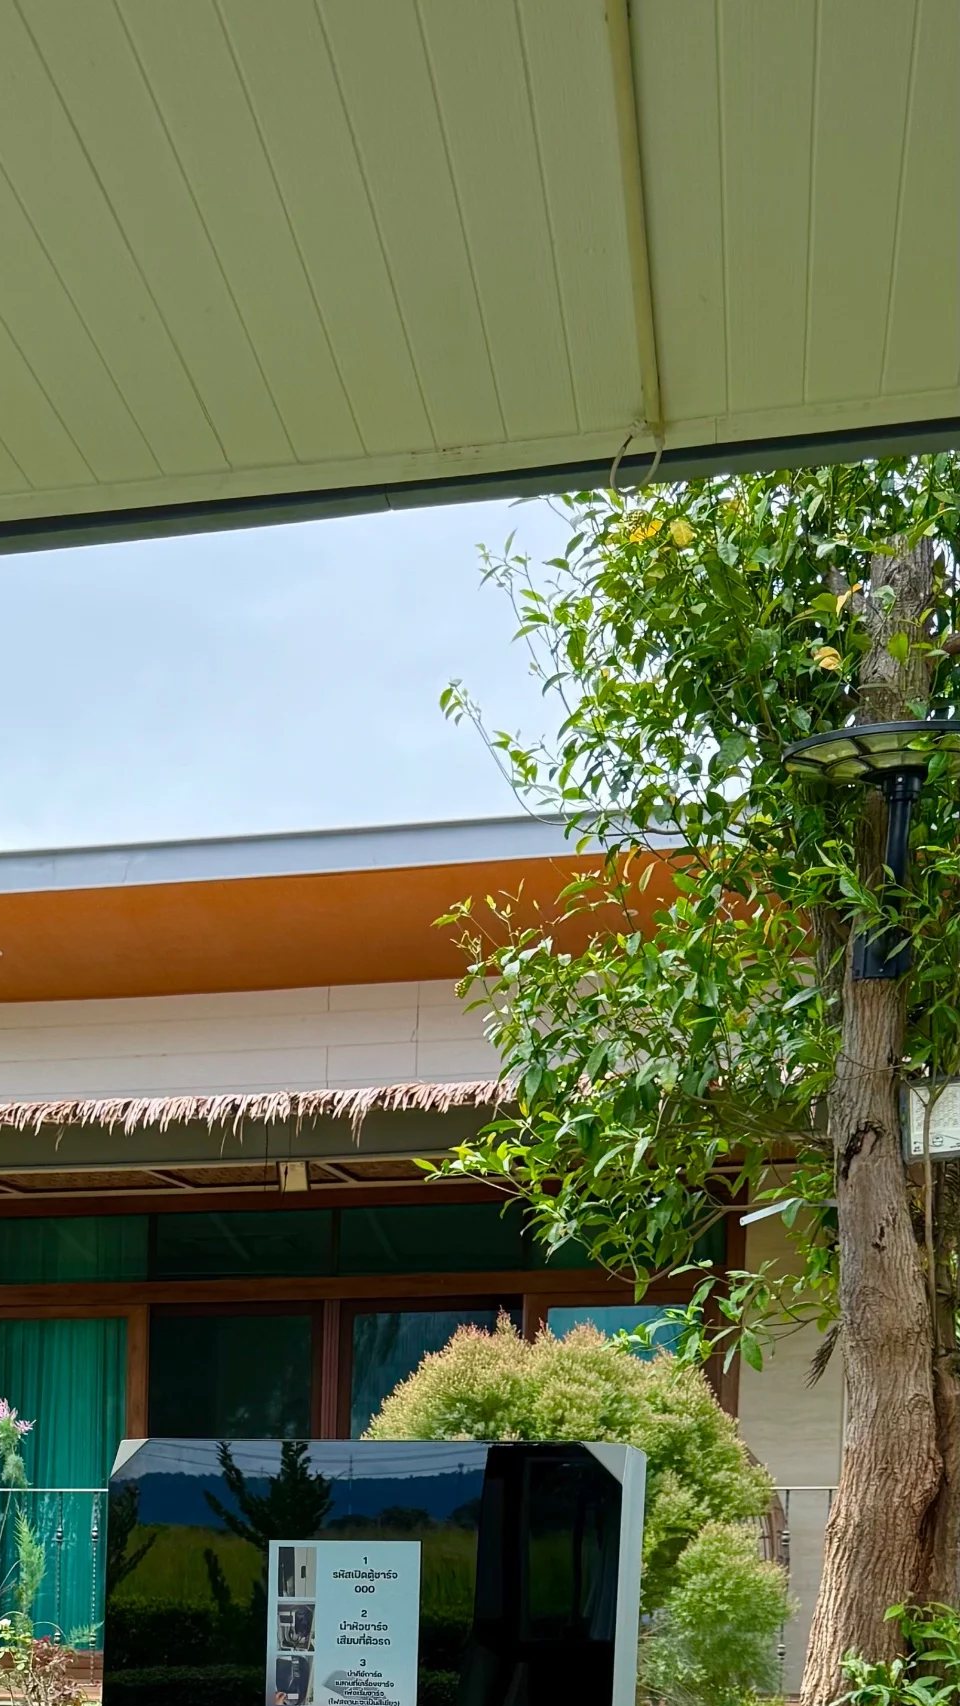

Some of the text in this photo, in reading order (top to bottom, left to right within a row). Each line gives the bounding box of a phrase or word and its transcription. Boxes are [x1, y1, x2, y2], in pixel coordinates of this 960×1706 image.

[362, 1556, 368, 1565] 1
[332, 1568, 399, 1582] รหัสเปิดตู้ชาร์จ
[360, 1609, 368, 1618] 2
[339, 1620, 389, 1632] นำหัวชาร์จ
[336, 1632, 391, 1646] เสียบที่ตัวรถ
[359, 1658, 367, 1667] 3
